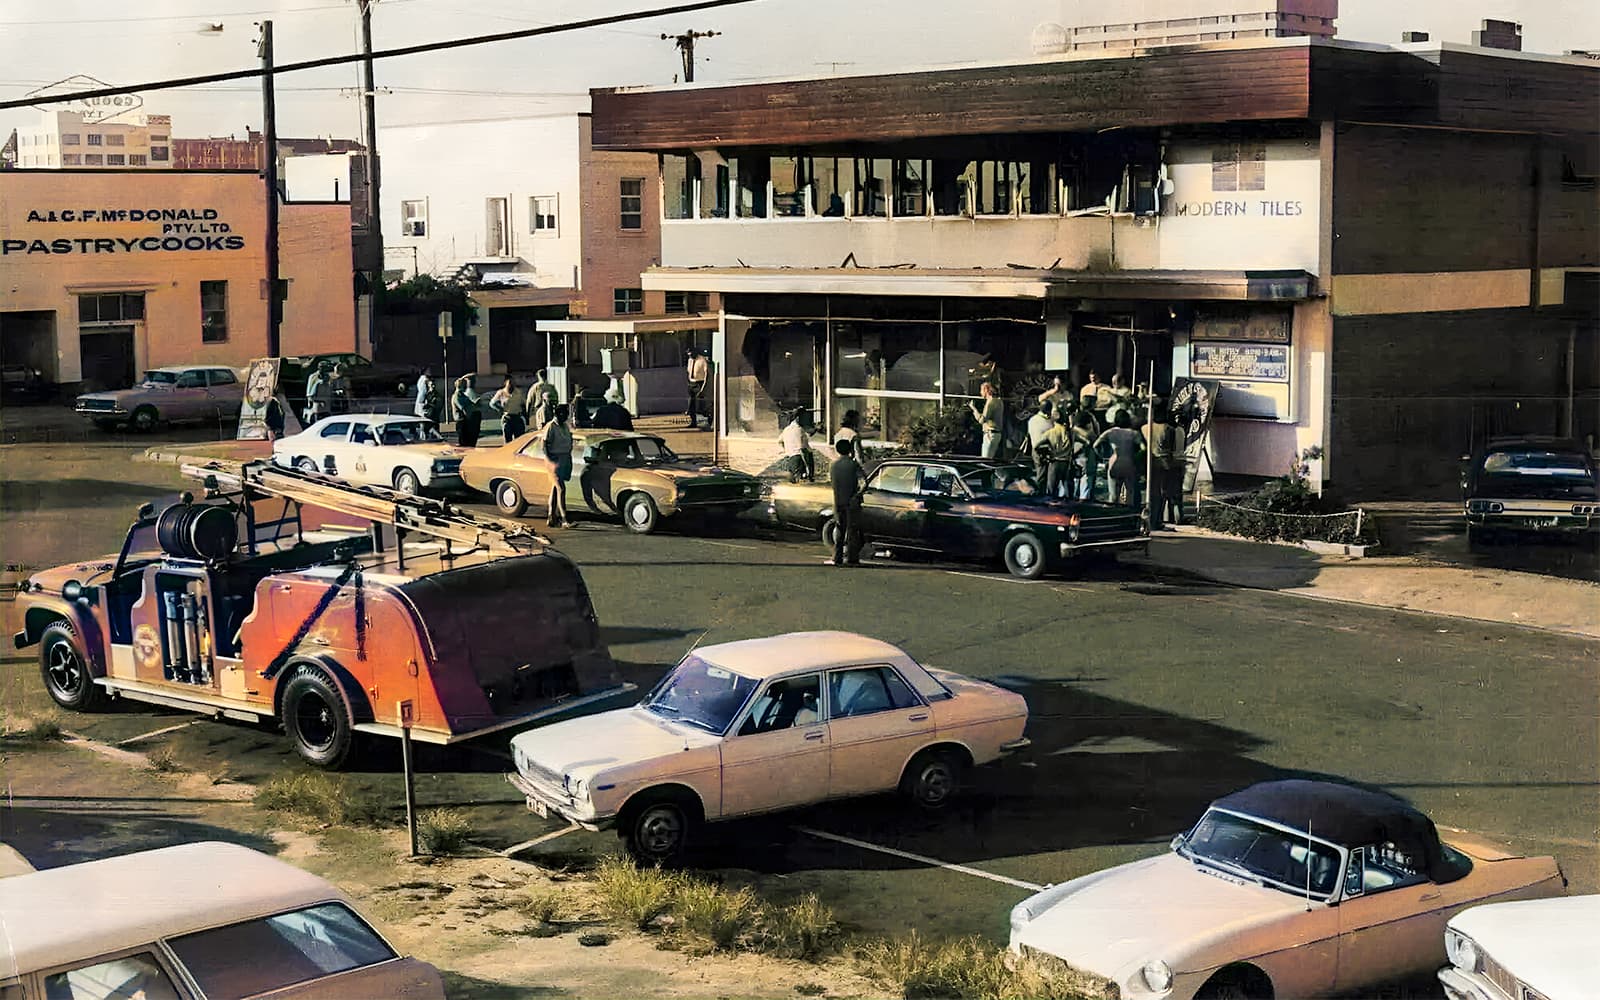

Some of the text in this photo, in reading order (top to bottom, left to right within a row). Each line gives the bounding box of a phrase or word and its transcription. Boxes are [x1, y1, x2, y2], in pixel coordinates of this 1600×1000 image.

[1175, 201, 1302, 217] MODERN TILES
[163, 223, 232, 234] PTY. LTD.
[2, 236, 245, 255] PASTRYCOOKS
